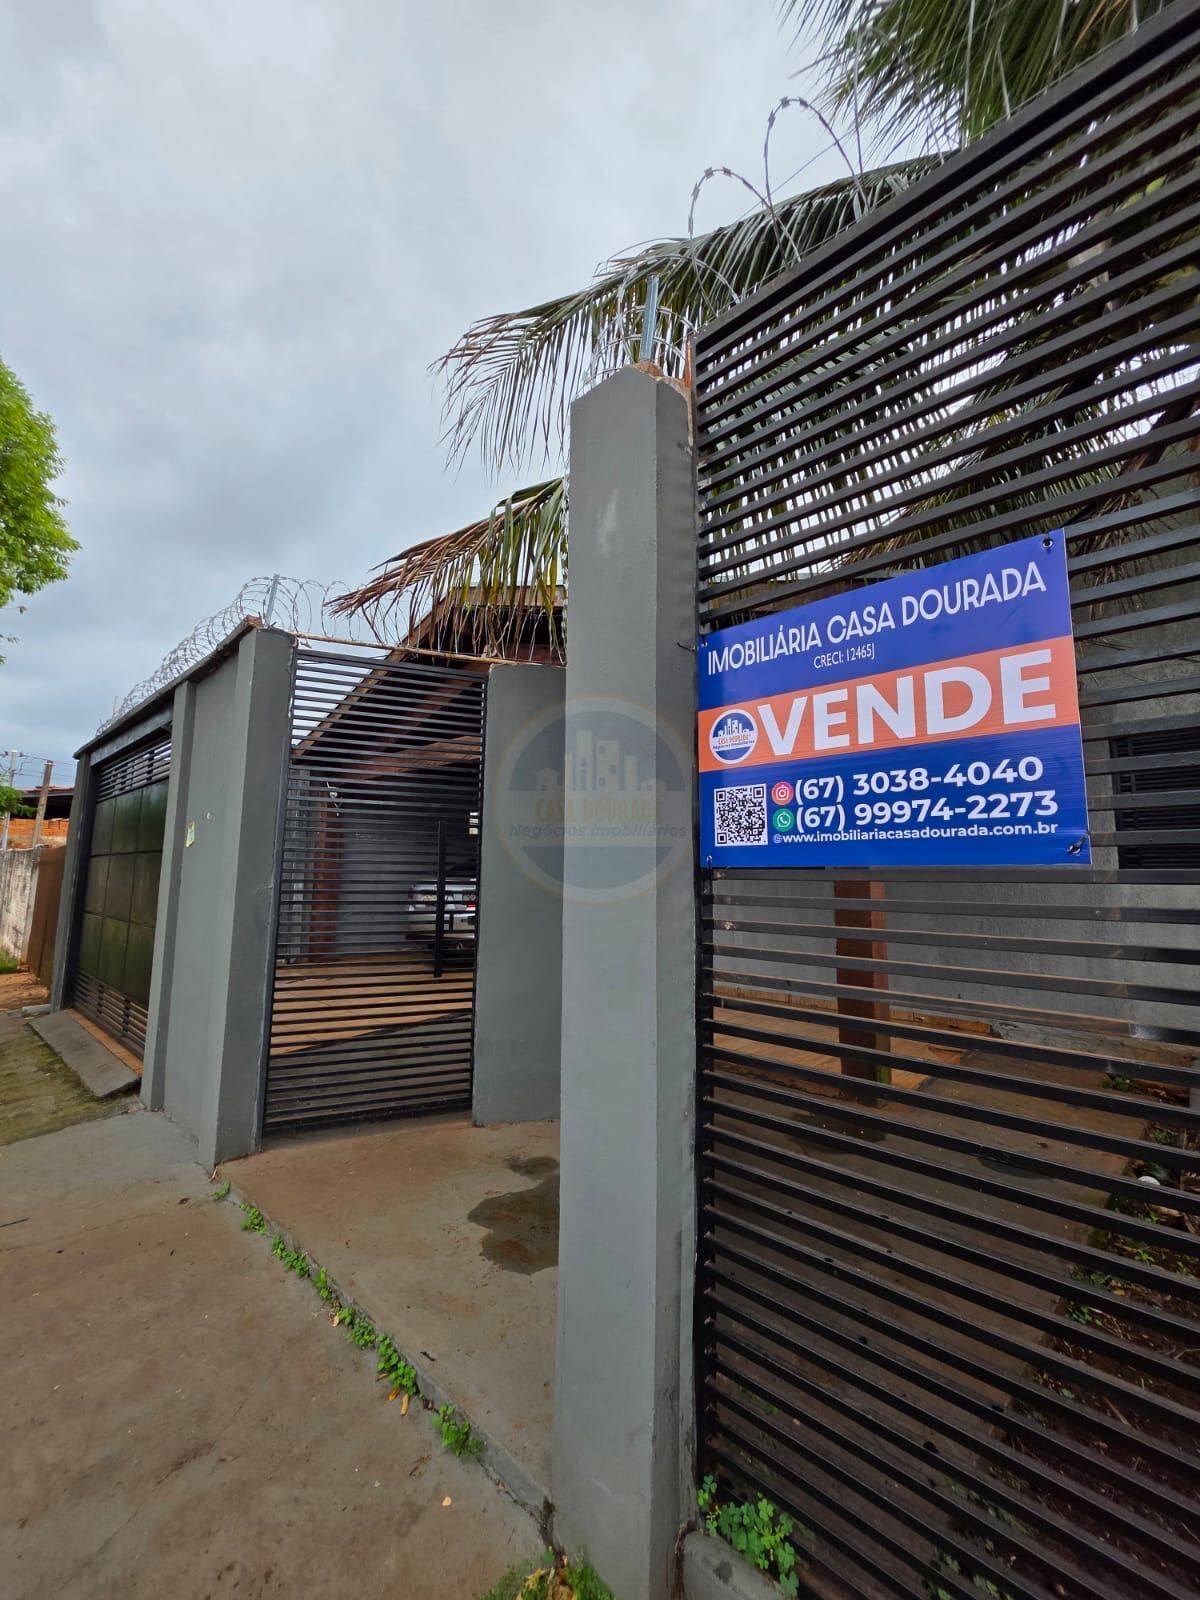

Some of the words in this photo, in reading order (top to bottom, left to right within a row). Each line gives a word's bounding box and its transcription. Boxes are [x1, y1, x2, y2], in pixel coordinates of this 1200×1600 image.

[707, 624, 822, 675] IMOBILIÁRIA
[826, 602, 895, 644] CASA
[901, 560, 1047, 626] DOURADA
[813, 653, 844, 669] CRECI:
[846, 644, 876, 662] 12465J
[758, 648, 1057, 756] VENDE
[795, 775, 845, 803] (67)
[853, 756, 1044, 796] 3038-4040
[782, 821, 1058, 843] www.imobiliariacasadourada.com.br
[796, 806, 846, 833] (67)
[855, 789, 1058, 826] 99974-2273
